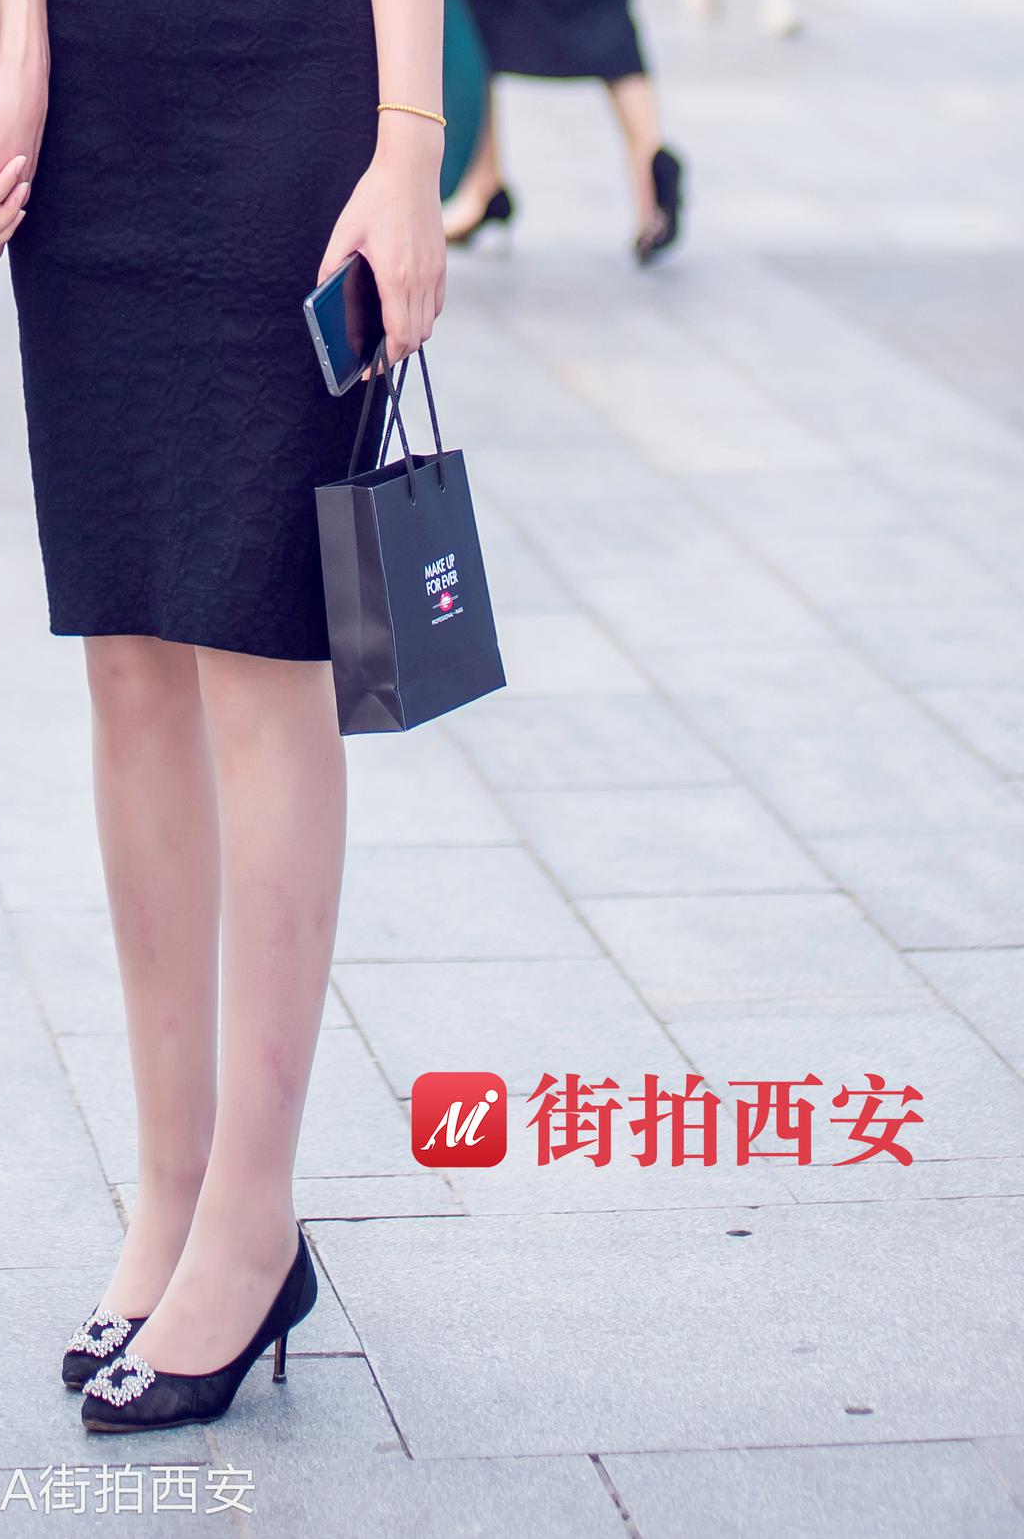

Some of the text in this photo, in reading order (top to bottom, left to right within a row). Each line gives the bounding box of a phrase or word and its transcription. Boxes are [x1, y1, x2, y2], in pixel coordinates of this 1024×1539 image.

[424, 553, 456, 580] MAKE UP
[426, 569, 459, 596] FOR EVER
